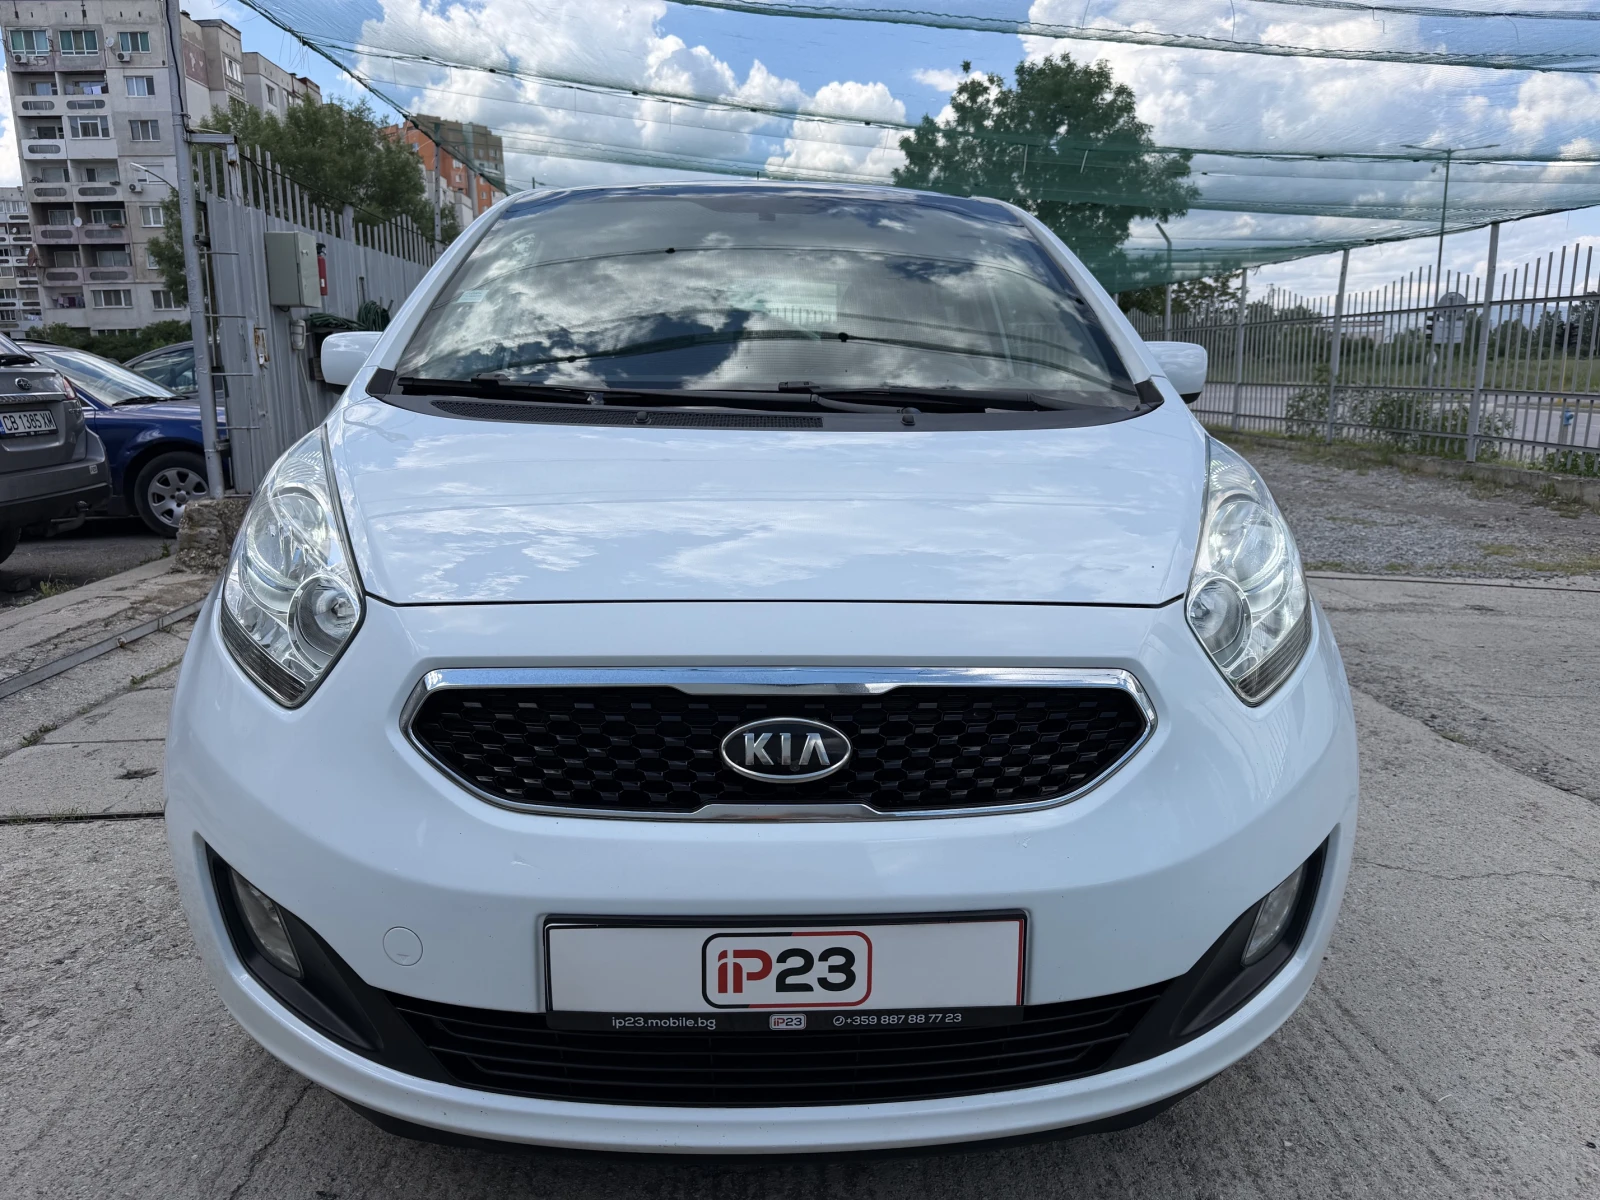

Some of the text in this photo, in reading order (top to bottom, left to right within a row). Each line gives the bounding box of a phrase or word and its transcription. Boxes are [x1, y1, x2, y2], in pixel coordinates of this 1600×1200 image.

[2, 415, 19, 431] CB
[19, 413, 42, 430] 1385
[743, 732, 830, 765] KIA
[612, 1016, 716, 1030] ip23.mobile.bg
[846, 1013, 962, 1025] +359 887 88 77 23
